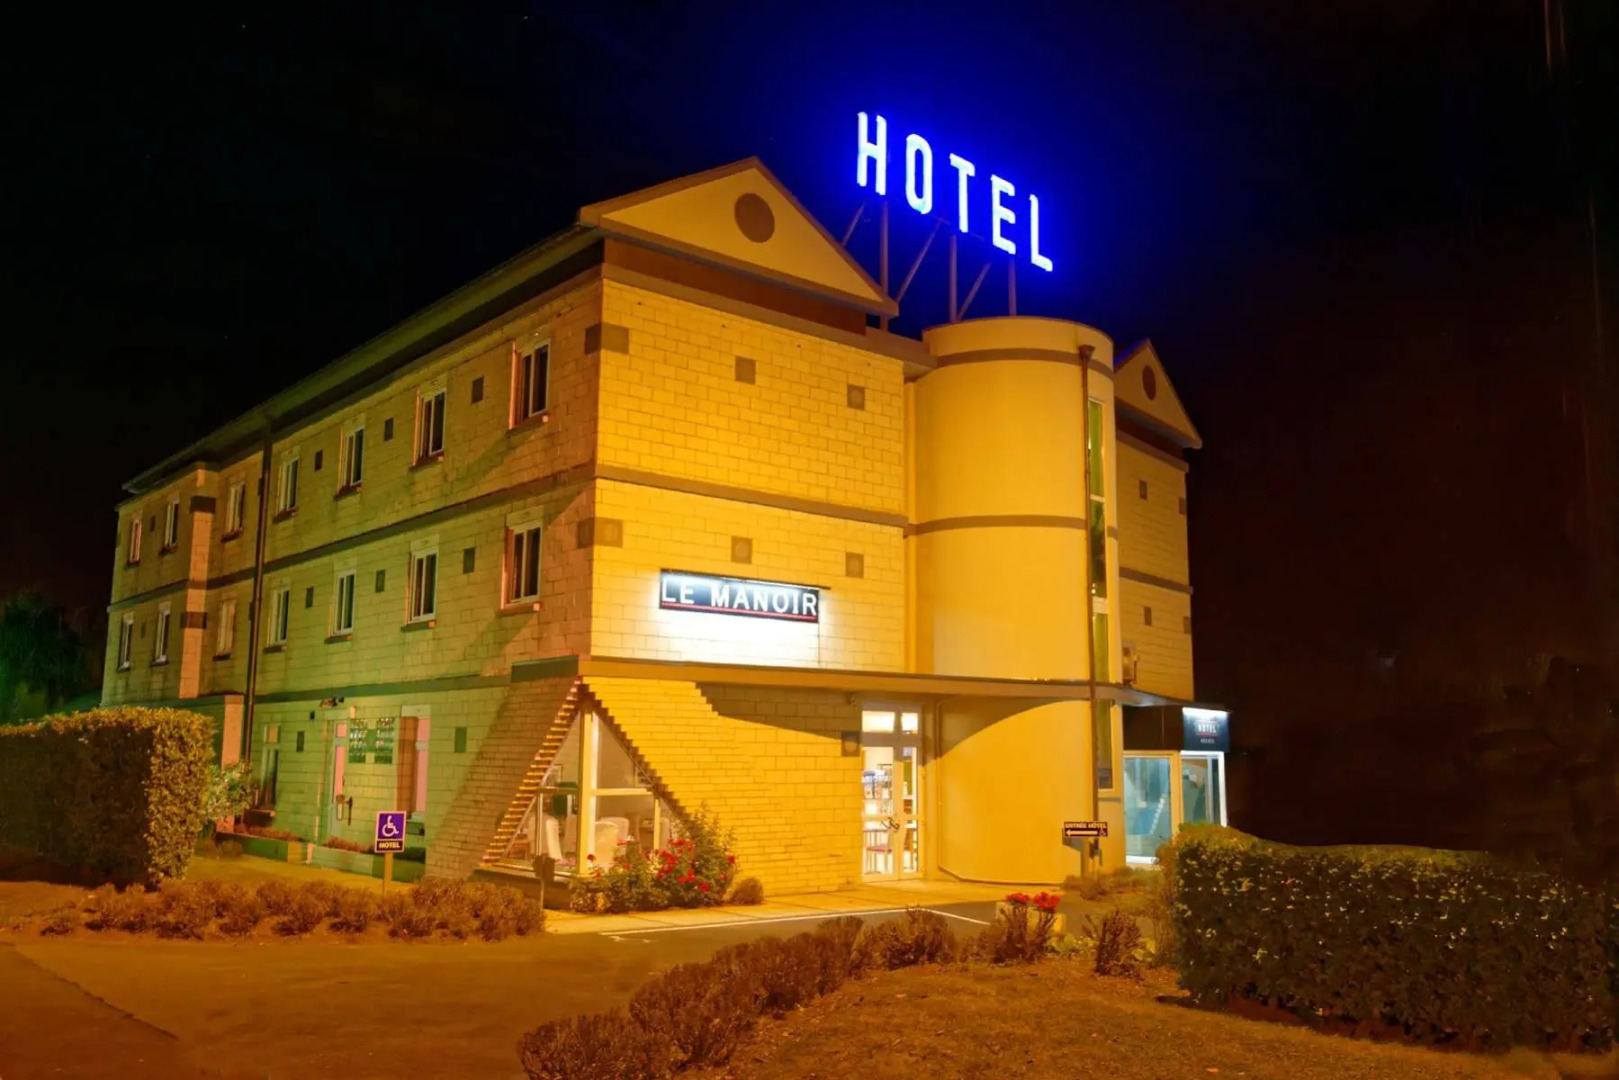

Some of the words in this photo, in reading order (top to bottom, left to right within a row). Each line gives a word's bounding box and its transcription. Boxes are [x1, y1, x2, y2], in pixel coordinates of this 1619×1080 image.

[856, 111, 1053, 272] HOTEL
[662, 577, 695, 604] LE
[710, 583, 817, 616] MANOIR
